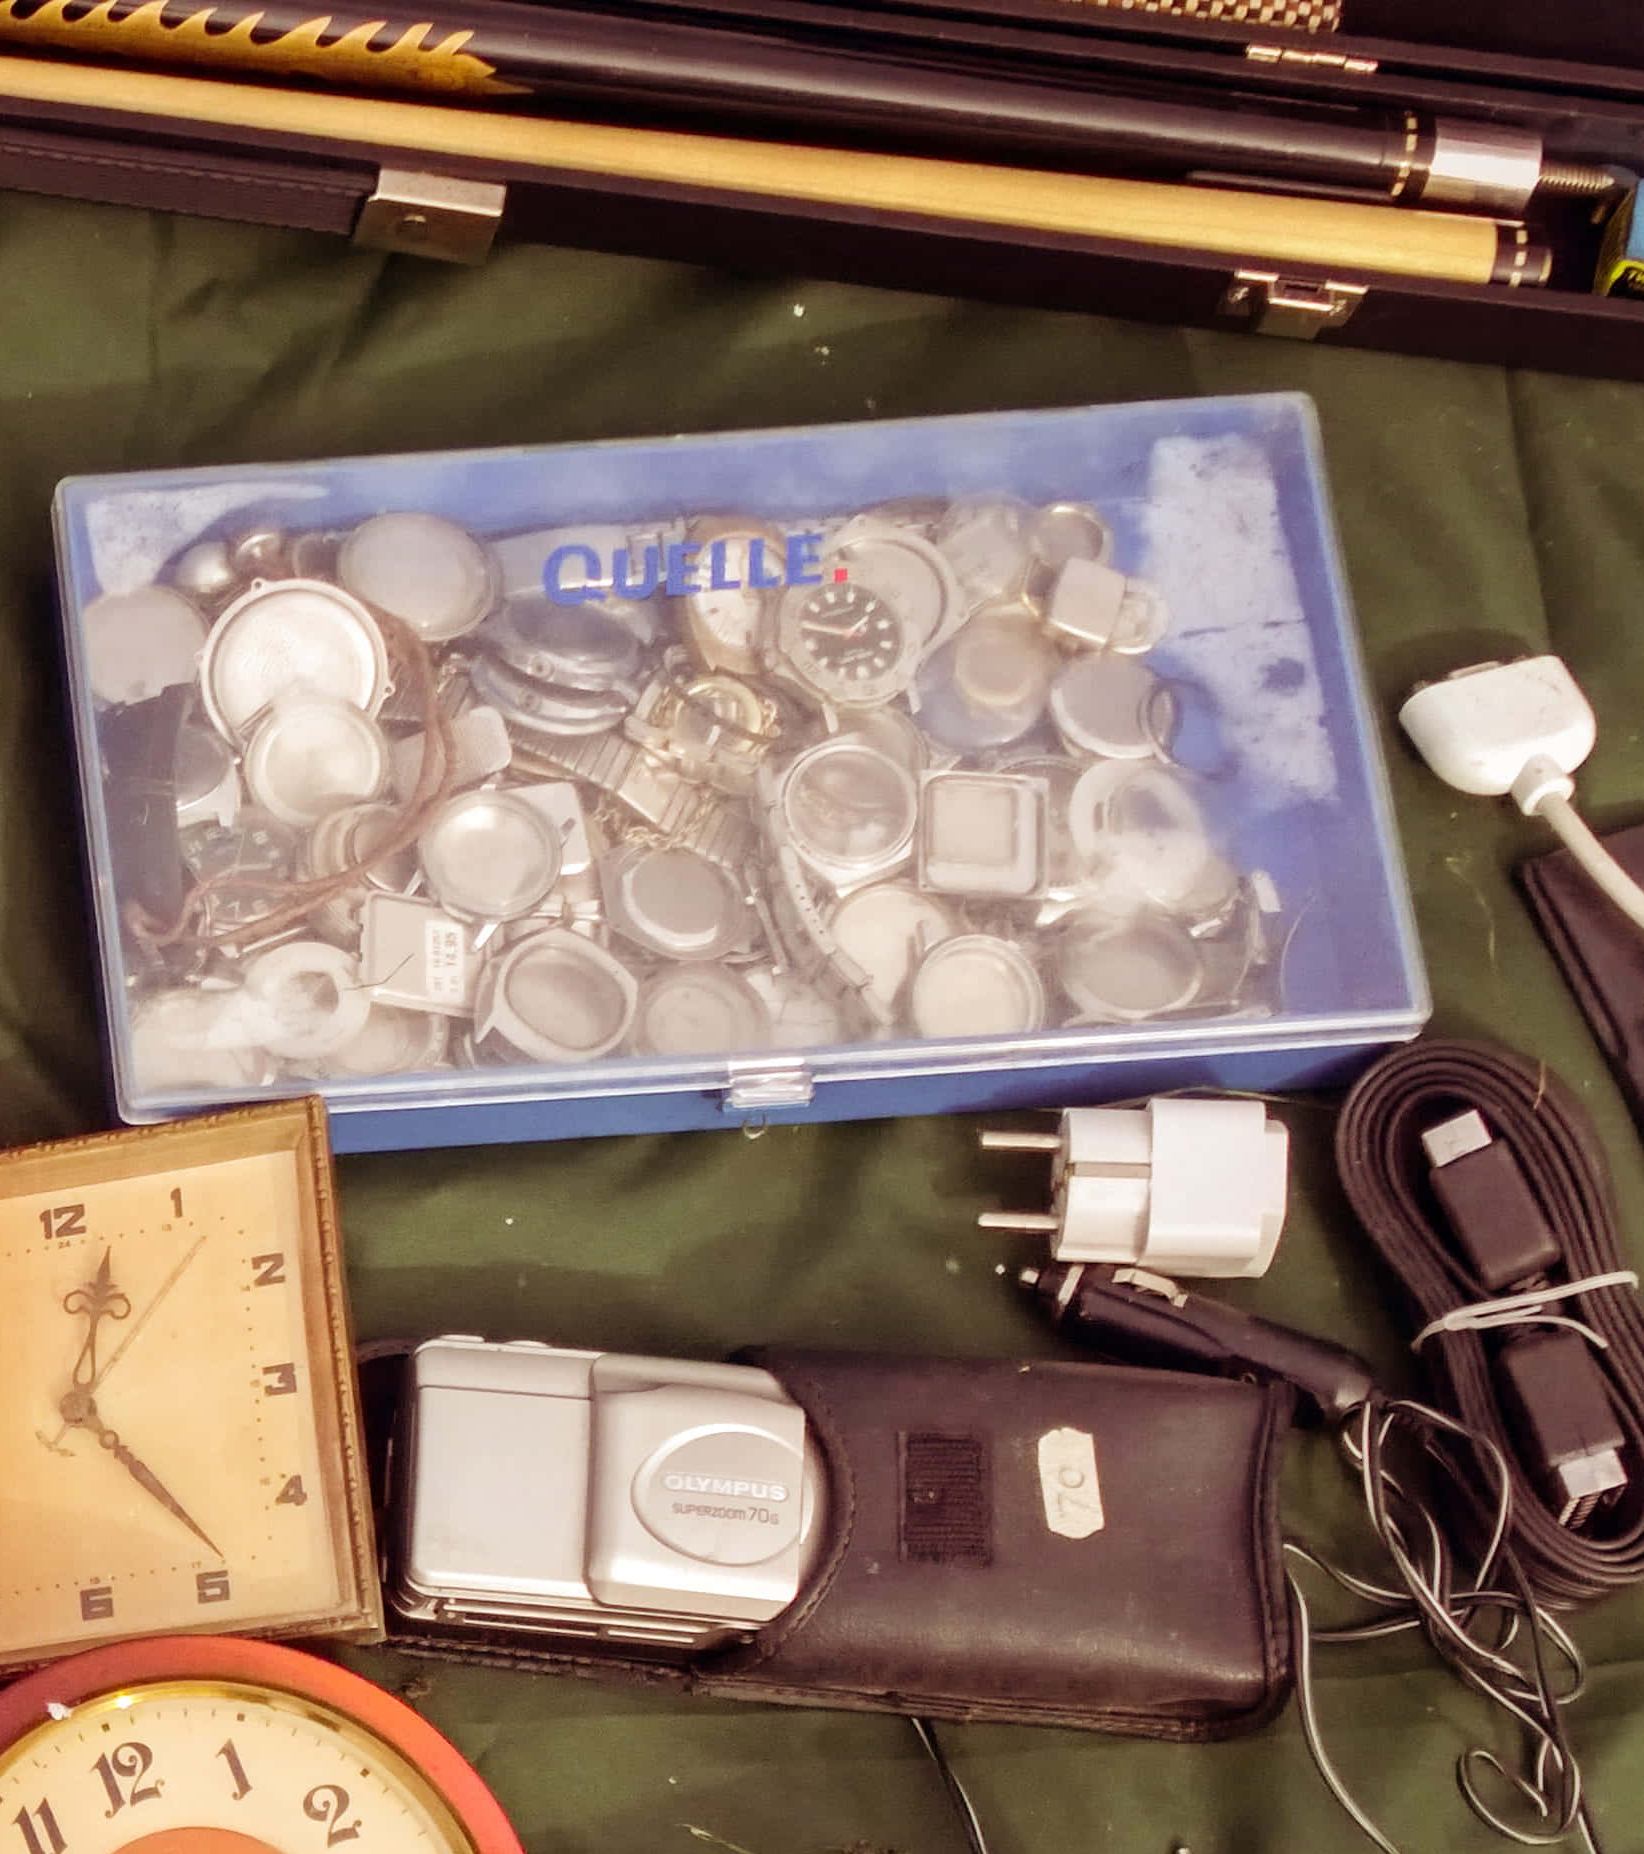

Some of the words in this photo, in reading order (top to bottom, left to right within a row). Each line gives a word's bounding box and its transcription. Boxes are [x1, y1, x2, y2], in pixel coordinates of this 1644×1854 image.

[170, 1187, 183, 1218] 1
[40, 1204, 87, 1240] 12
[252, 1252, 285, 1287] 2
[263, 1363, 298, 1395] 3
[276, 1475, 308, 1507] 4
[665, 1473, 787, 1502] OLYMPUS
[80, 1587, 114, 1620] 6
[196, 1571, 230, 1604] 5
[90, 1741, 165, 1818] 12
[216, 1738, 253, 1801] 1
[302, 1783, 363, 1848] 2
